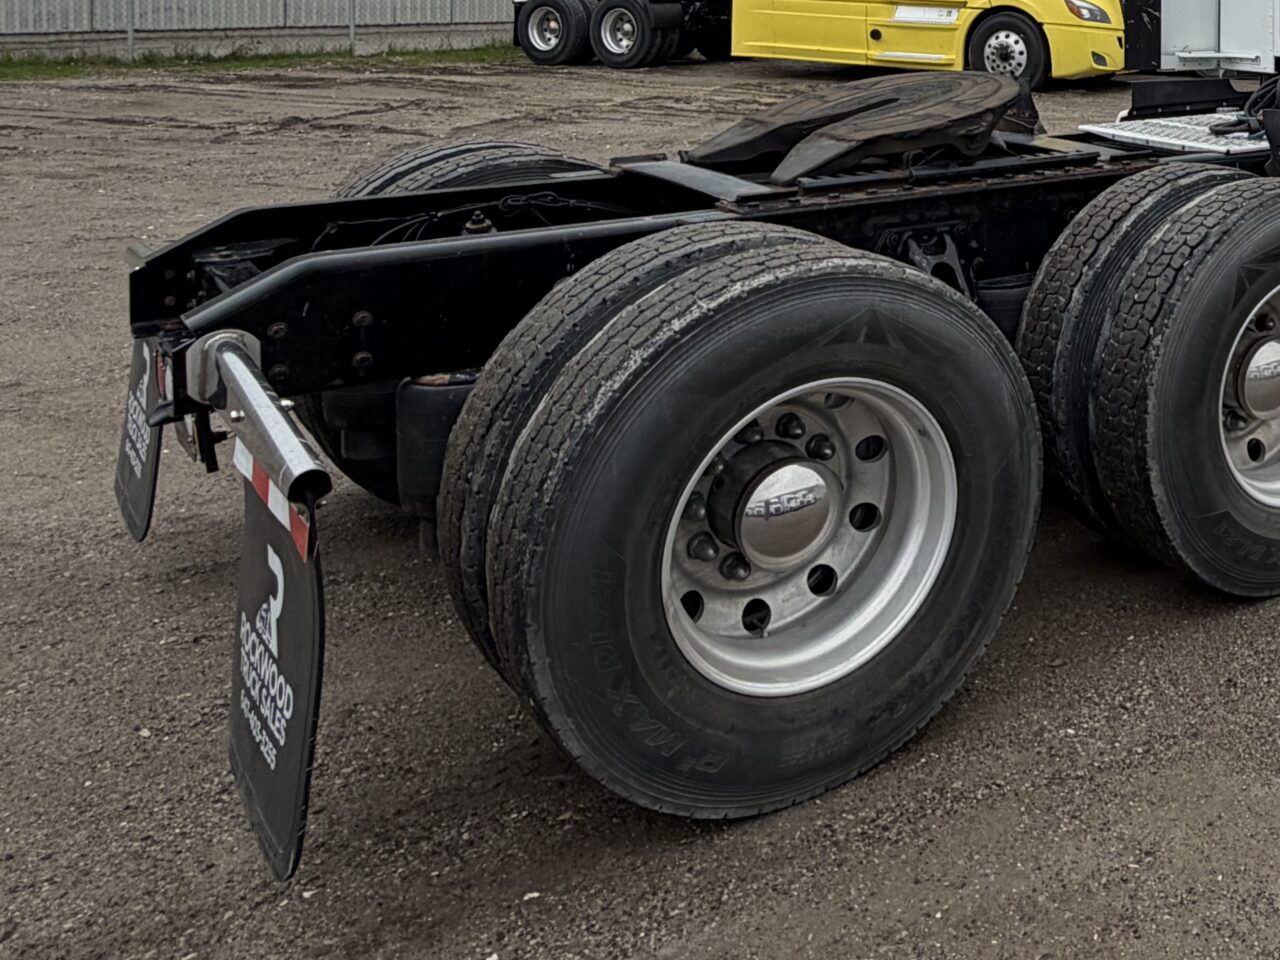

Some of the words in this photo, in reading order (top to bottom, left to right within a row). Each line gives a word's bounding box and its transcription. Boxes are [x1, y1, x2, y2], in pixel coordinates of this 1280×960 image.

[240, 611, 294, 720] ROCKWOOD
[240, 646, 262, 706] TRUCK
[260, 687, 287, 747] SALES
